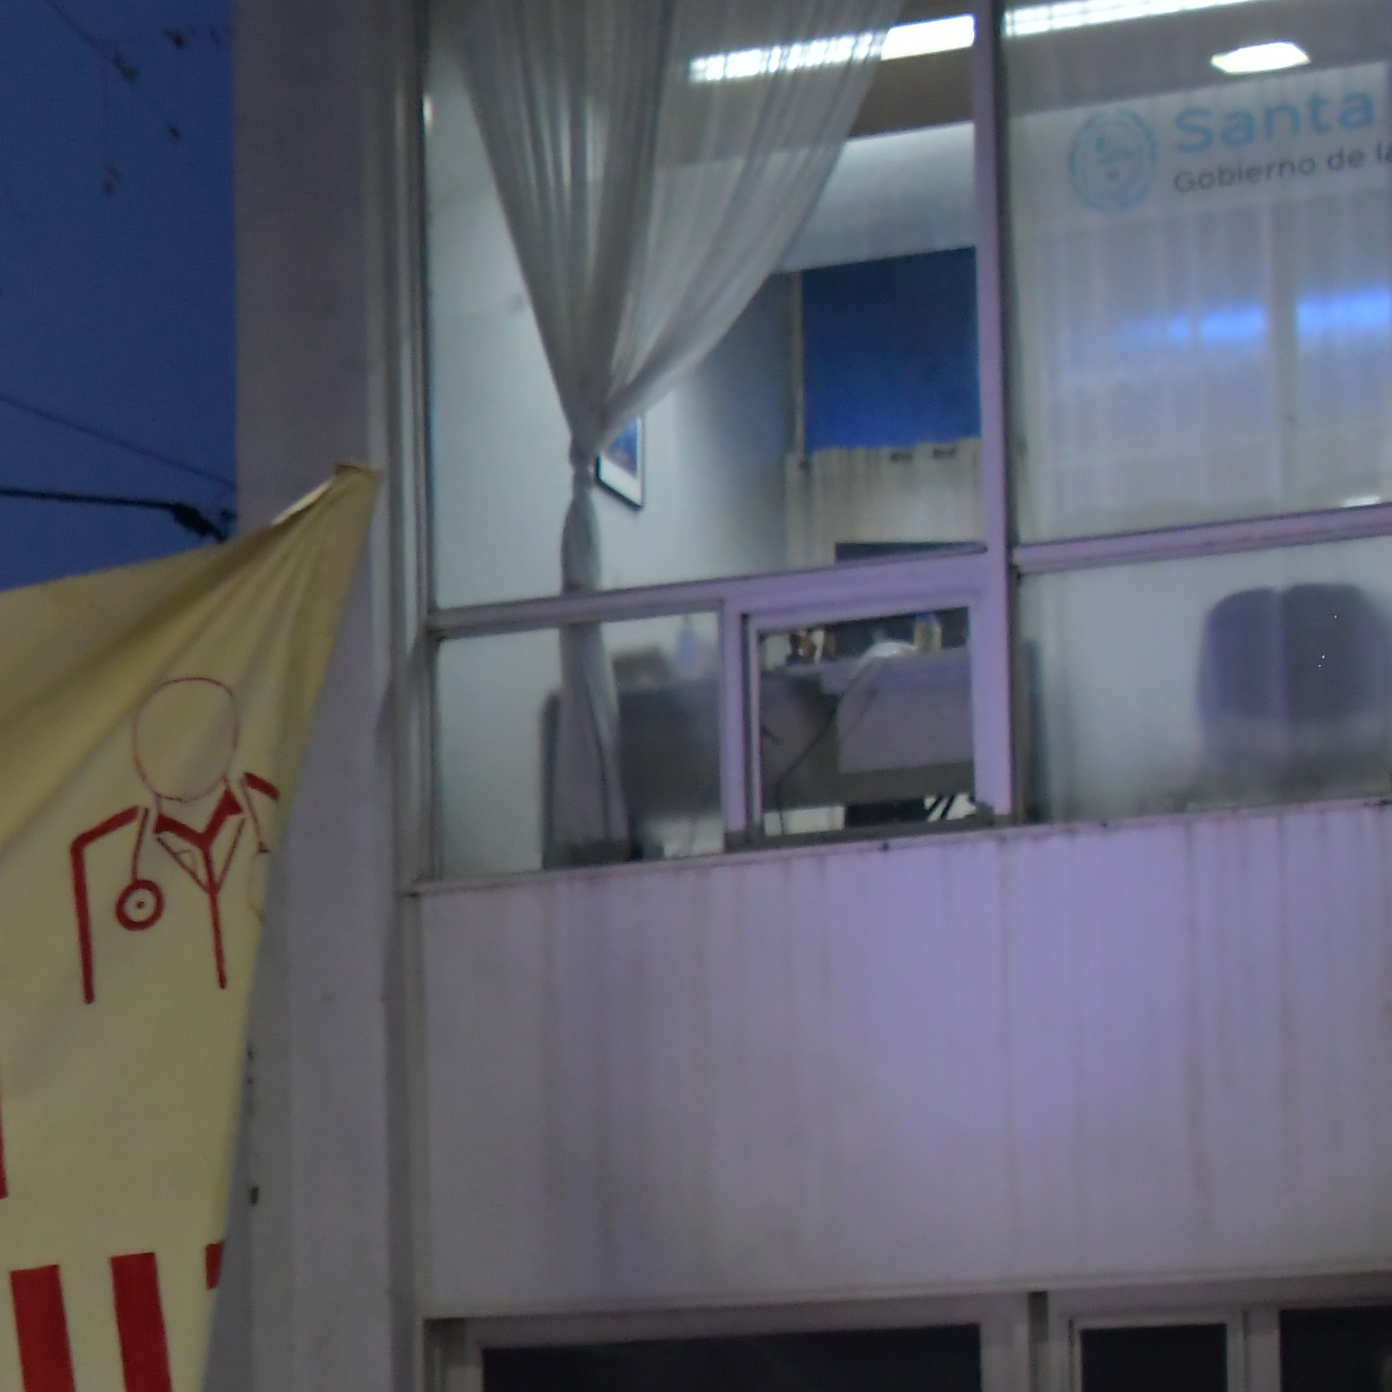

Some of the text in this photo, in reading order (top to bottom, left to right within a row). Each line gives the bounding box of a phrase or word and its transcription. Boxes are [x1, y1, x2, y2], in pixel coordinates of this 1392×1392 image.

[1173, 91, 1376, 154] Santa
[1173, 154, 1316, 194] Gobierno
[1326, 146, 1366, 172] de
